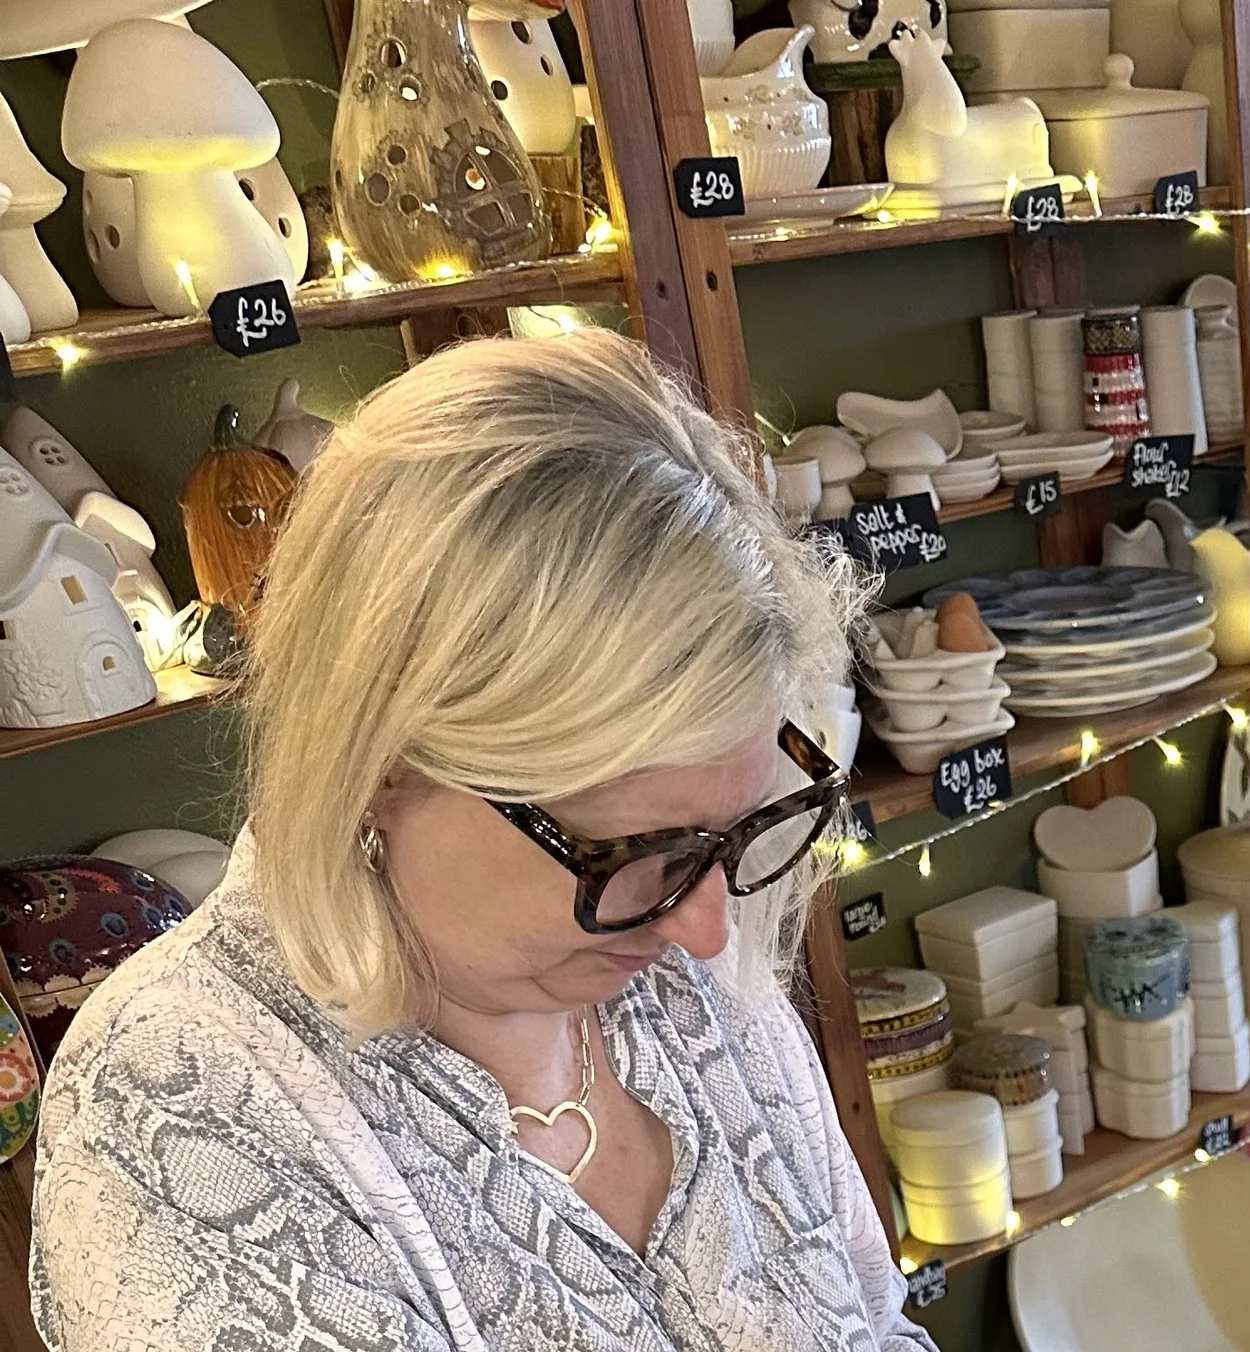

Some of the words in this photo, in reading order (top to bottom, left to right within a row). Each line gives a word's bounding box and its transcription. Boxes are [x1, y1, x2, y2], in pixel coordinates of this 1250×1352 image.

[690, 171, 734, 208] £28
[1165, 184, 1194, 216] £28
[1027, 196, 1059, 232] £28
[236, 297, 287, 347] £26
[1025, 480, 1057, 515] £15
[856, 505, 895, 535] Salt
[918, 532, 947, 563] £20
[941, 760, 971, 793] Egg
[974, 748, 1005, 773] box
[964, 775, 997, 813] £26
